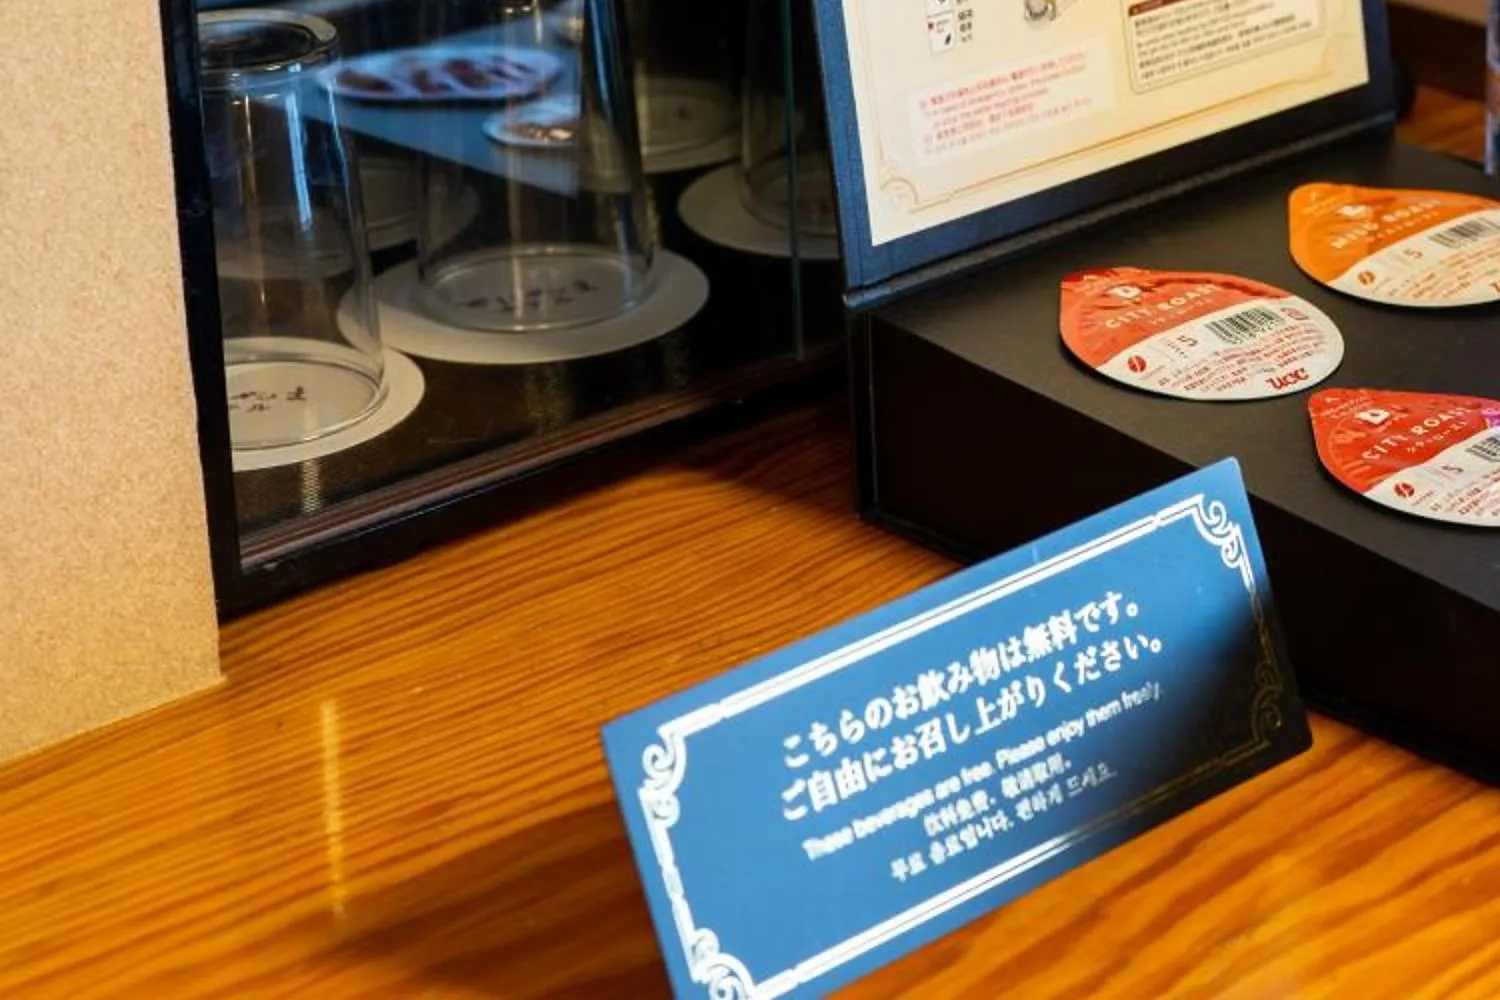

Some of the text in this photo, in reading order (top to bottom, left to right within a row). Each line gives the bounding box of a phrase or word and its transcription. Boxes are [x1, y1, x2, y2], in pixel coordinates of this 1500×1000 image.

[1362, 434, 1408, 460] CITY
[781, 633, 1162, 821] ご自由にお召し上がりください。
[783, 590, 1139, 768] こちらのお飲み物は無料です。
[1046, 717, 1085, 743] enjoy
[1086, 699, 1123, 727] them
